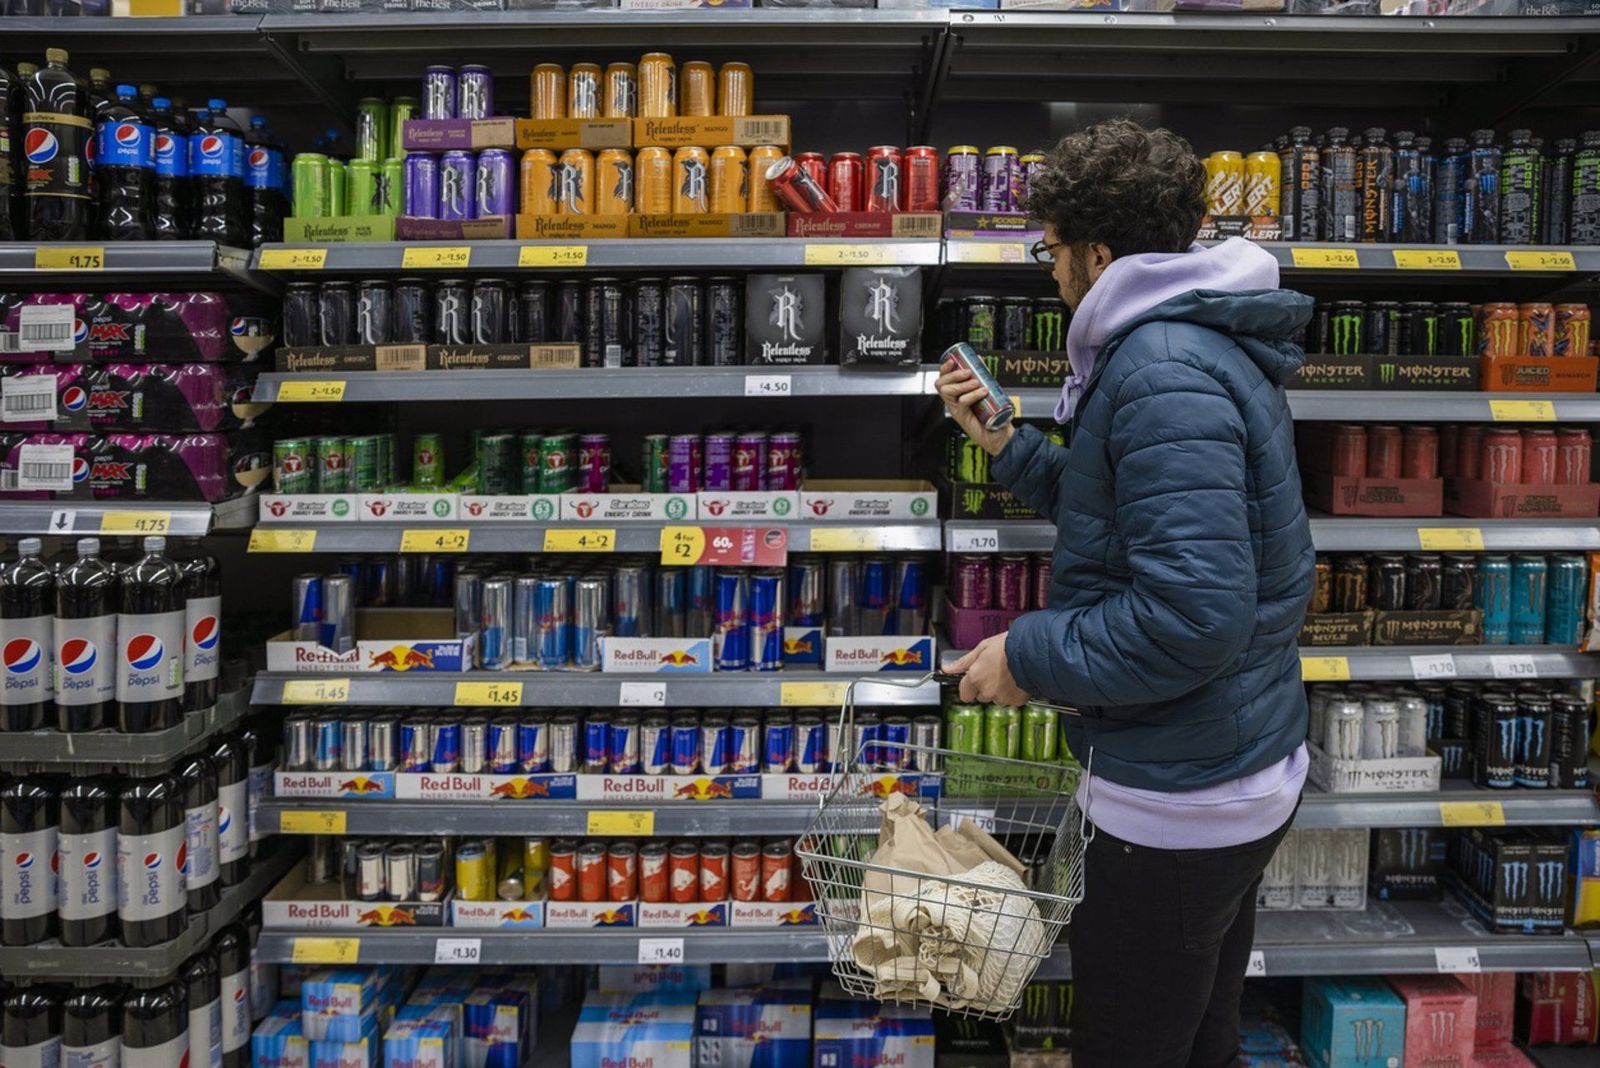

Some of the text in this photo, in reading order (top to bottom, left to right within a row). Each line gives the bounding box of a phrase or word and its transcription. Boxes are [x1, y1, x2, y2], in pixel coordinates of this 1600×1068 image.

[646, 121, 698, 141] Relentless
[536, 217, 585, 237] Relentless
[640, 215, 690, 234] Relentless
[796, 217, 847, 238] Relentless
[70, 255, 101, 269] £1.75
[856, 334, 908, 356] Relentless
[761, 341, 815, 363] Relentless
[1004, 357, 1069, 376] MONST
[1399, 363, 1471, 379] MONSTER
[1021, 376, 1061, 384] ENER
[135, 519, 167, 532] £1.75
[435, 536, 444, 548] 4
[578, 535, 587, 547] 4
[674, 532, 682, 541] 4
[971, 537, 997, 548] £1.70
[675, 543, 691, 558] £2
[1302, 623, 1360, 634] MONSTER
[1401, 619, 1462, 631] MONSTER
[194, 654, 218, 667] peps
[614, 650, 657, 660] Red Bull
[835, 649, 879, 660] Red Bull
[5, 678, 39, 691] pepsi
[62, 678, 95, 691] pepsi
[128, 675, 160, 689] pepsi
[488, 690, 519, 703] £1.45
[1364, 768, 1430, 781] MONSTER
[283, 777, 332, 789] Red Bull
[421, 777, 482, 792] Red Bull
[604, 778, 665, 793] Red Bull
[19, 871, 32, 905] pepsi
[88, 871, 99, 905] pepsi
[148, 871, 160, 905] pepsi
[288, 904, 350, 919] Red Bull
[458, 908, 496, 918] Red Bull
[550, 908, 588, 918] Red Bull
[642, 909, 681, 918] Red Bull
[735, 909, 774, 919] Red Bull
[453, 947, 478, 959] £1.30
[656, 947, 681, 959] £1.40
